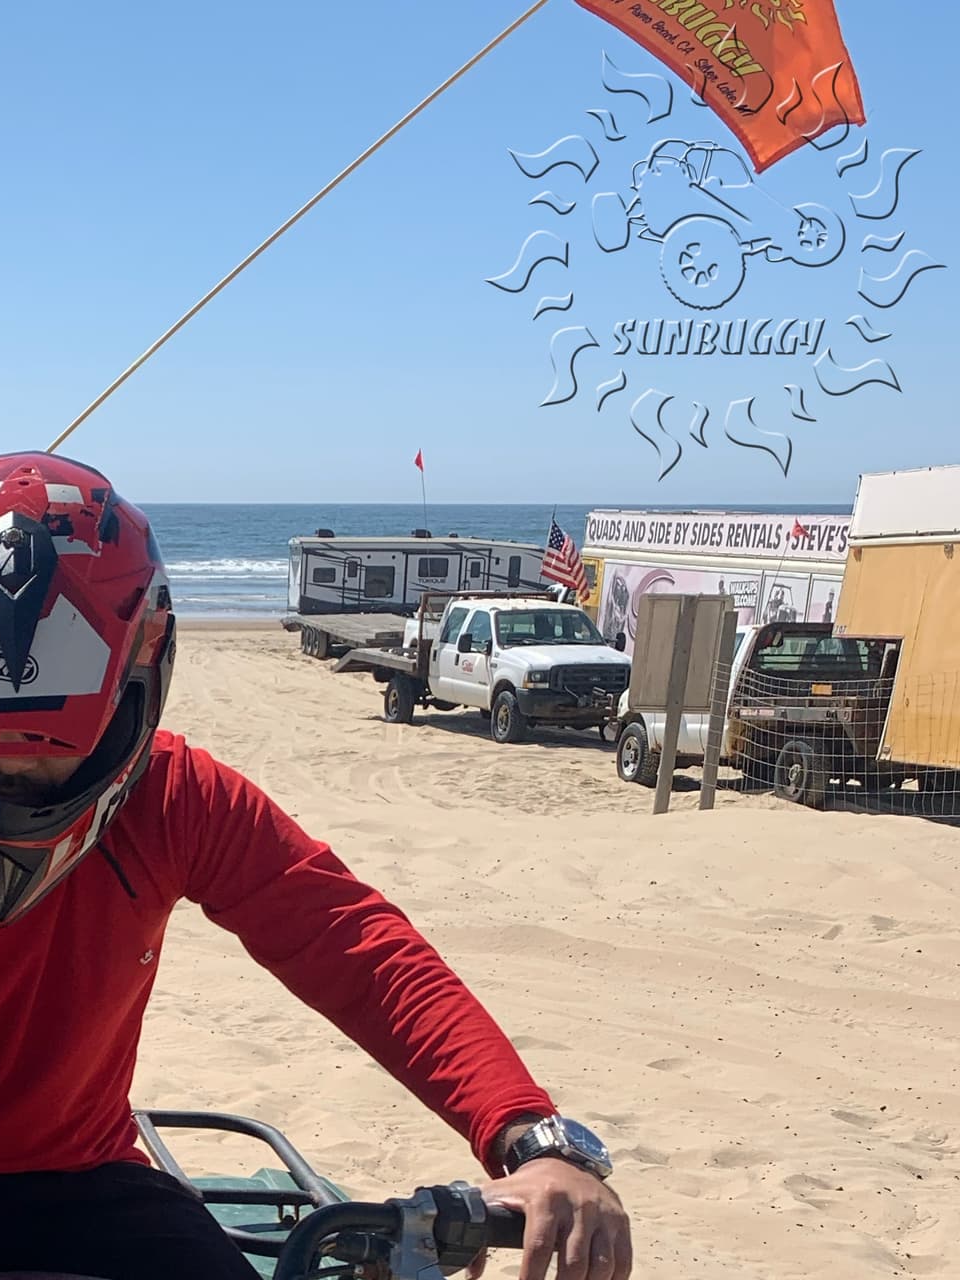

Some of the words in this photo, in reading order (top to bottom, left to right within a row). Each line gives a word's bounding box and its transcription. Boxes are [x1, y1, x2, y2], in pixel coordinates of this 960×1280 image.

[648, 0, 765, 77] BUGGY
[676, 40, 695, 55] CA
[588, 519, 621, 542] QUADS
[622, 520, 646, 542] AND
[647, 521, 673, 544] SIDE
[673, 522, 690, 545] BY
[690, 522, 724, 547] SIDES
[725, 523, 783, 549] RENTALS
[733, 594, 757, 607] ELCOME
